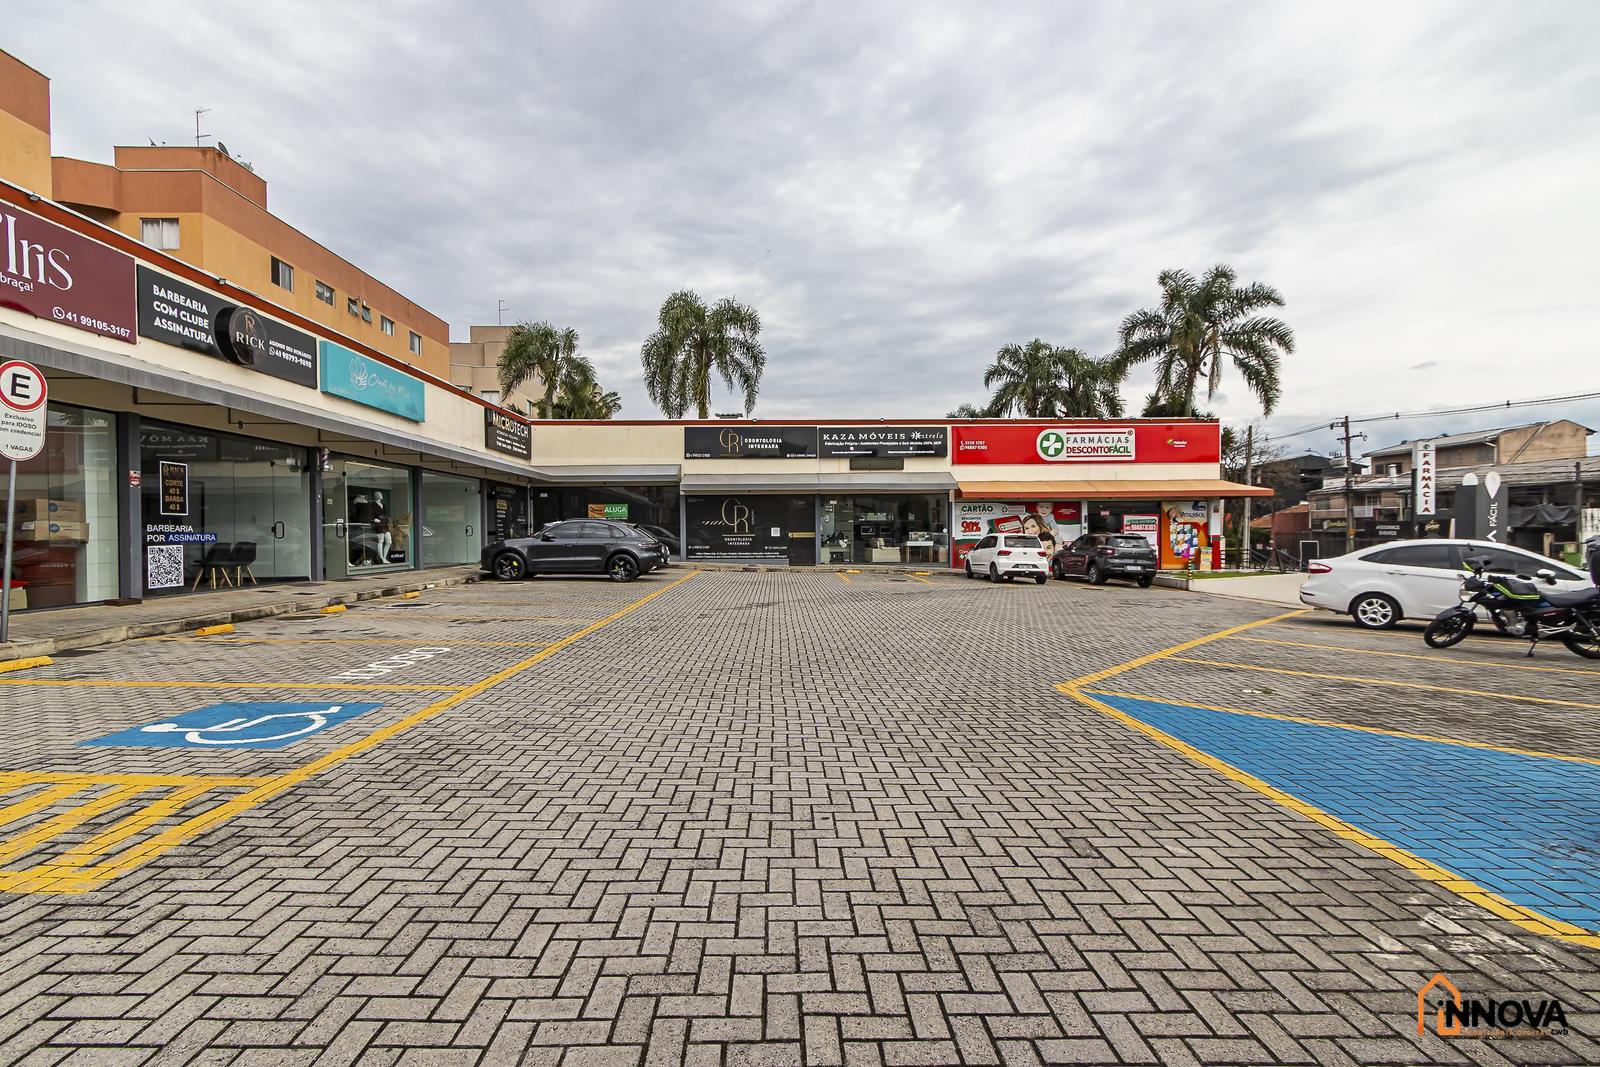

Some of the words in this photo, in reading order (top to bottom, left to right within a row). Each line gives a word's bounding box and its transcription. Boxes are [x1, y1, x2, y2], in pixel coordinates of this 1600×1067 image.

[0, 272, 34, 292] braça!
[153, 284, 208, 315] BARBEARIA
[66, 312, 78, 323] 41
[80, 315, 131, 338] 99105-3167
[153, 301, 178, 318] COM
[180, 309, 209, 330] CLUBE
[154, 316, 214, 345] ASSINATURA
[236, 331, 266, 351] RICK
[11, 373, 31, 400] E
[5, 413, 35, 423] Exclusivo
[17, 422, 37, 430] IDOSO
[492, 411, 529, 438] MICROTECH
[11, 429, 42, 437] credencial
[858, 431, 906, 440] MÓVEIS
[1066, 435, 1130, 444] FARMÁCIAS
[11, 445, 33, 453] VAGAS
[1066, 444, 1131, 454] DESCONTOFÁCIL
[1421, 452, 1433, 514] FARMÁCIA
[961, 504, 994, 513] CARTÃO
[1489, 502, 1498, 527] FÁCIL
[147, 534, 166, 542] POR
[168, 533, 216, 542] ASSINATURA
[327, 647, 451, 680] IDOSO
